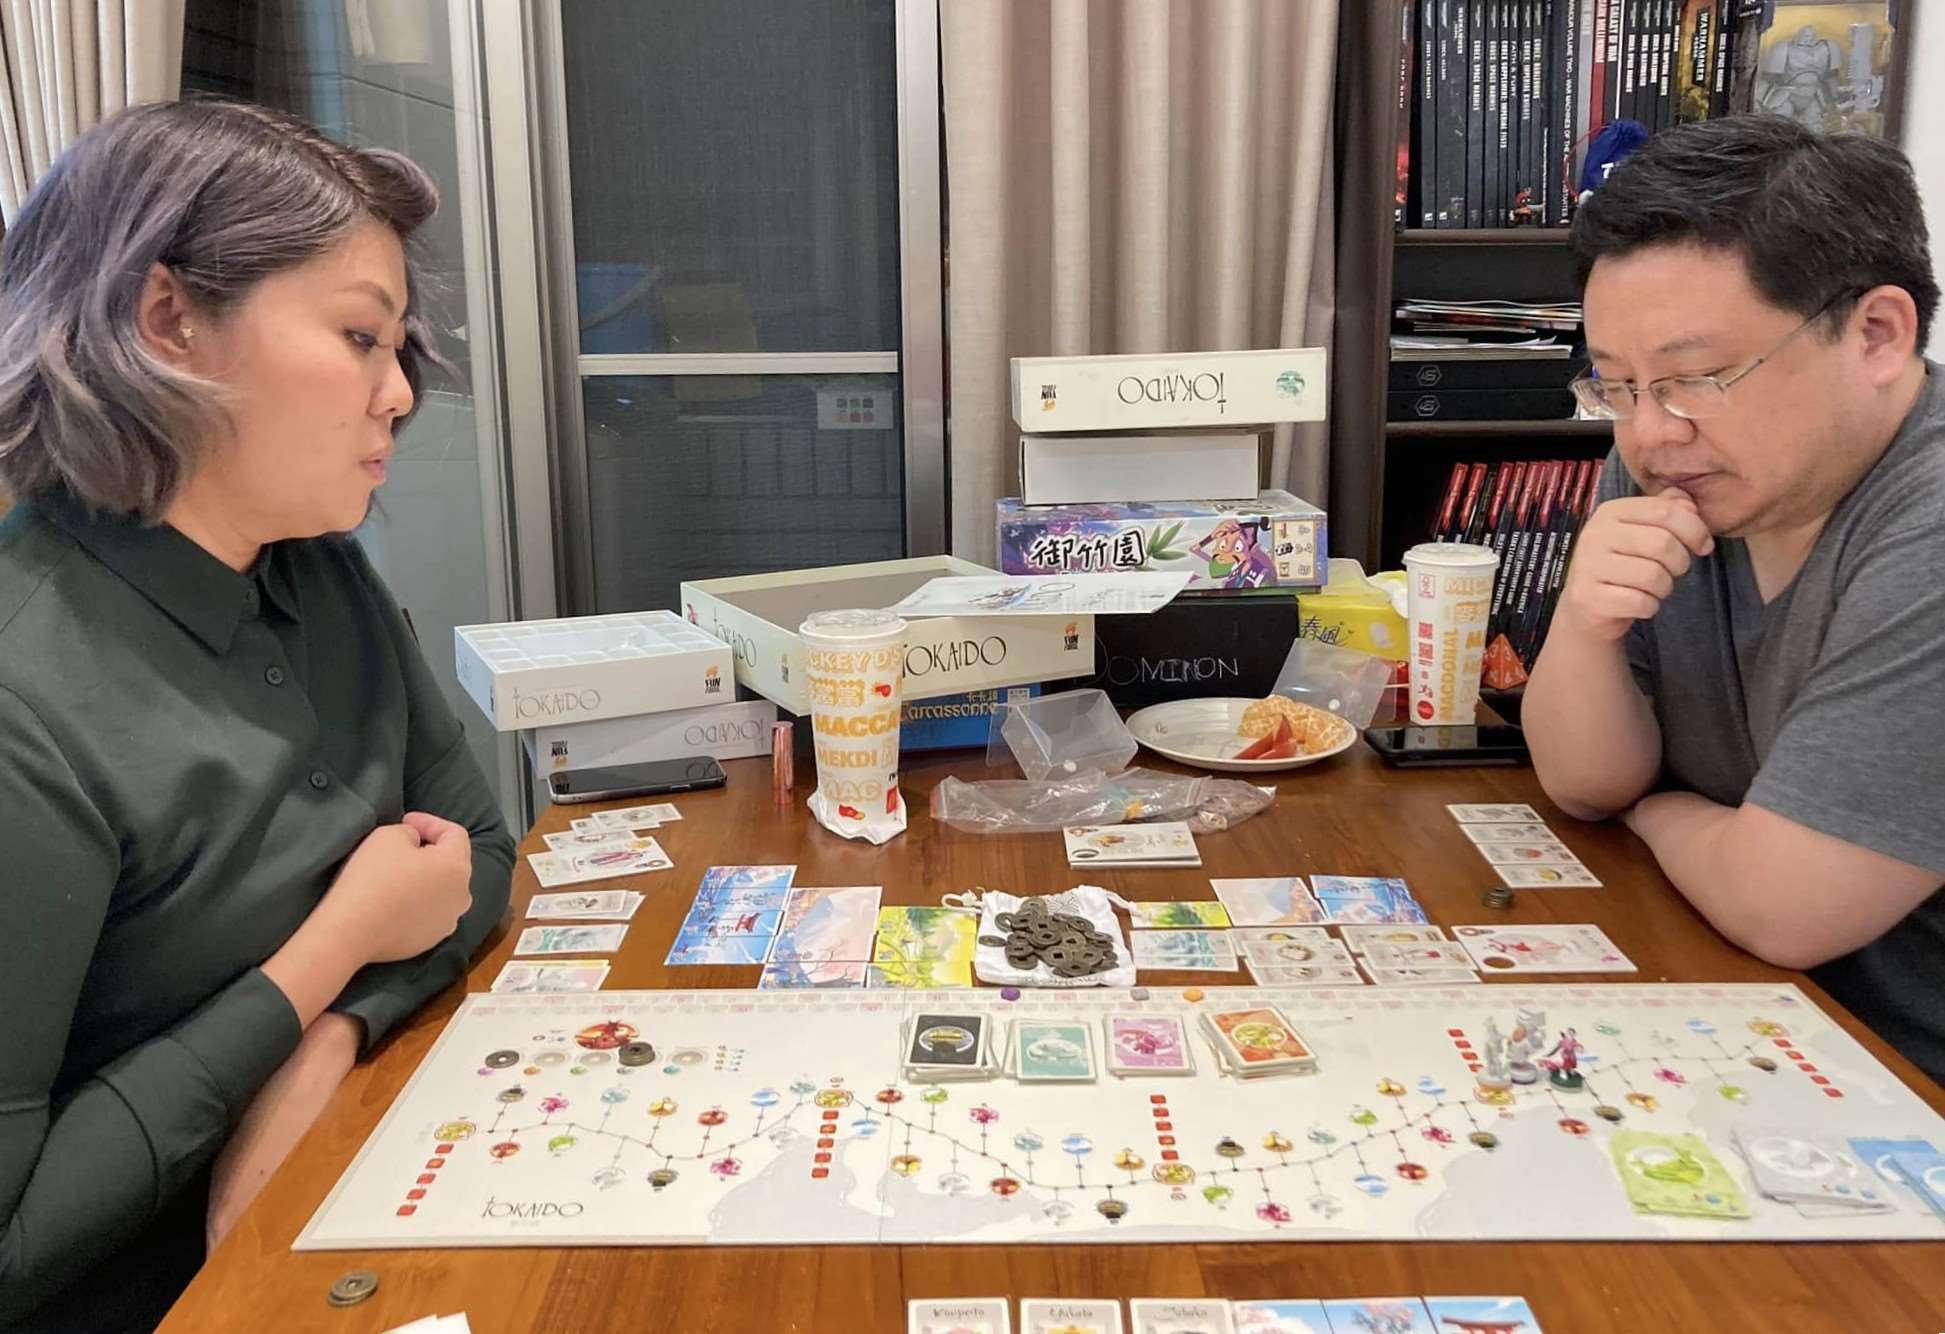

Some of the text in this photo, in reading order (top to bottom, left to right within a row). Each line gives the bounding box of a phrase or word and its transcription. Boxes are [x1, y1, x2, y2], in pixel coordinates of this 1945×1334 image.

[1456, 7, 1464, 54] WARHAMMER
[1609, 6, 1620, 34] GALAXY
[1566, 29, 1574, 56] VOLUME
[1607, 45, 1618, 62] WAR
[1696, 12, 1709, 82] WARHAMMER
[1473, 64, 1481, 83] SPACE
[1488, 64, 1497, 84] SPACE
[1522, 64, 1531, 93] IMPERIAL
[1565, 58, 1573, 73] TWO
[1472, 84, 1481, 111] MARINES
[1488, 85, 1497, 111] MARINES
[1565, 80, 1573, 94] WAR
[1500, 103, 1508, 130] IMPERIAL
[1521, 94, 1530, 120] KNIGHTS
[1563, 95, 1572, 129] MACHINES
[1563, 141, 1571, 154] THE
[1564, 130, 1571, 140] OF
[1118, 372, 1228, 414] TOKAIDO
[1030, 530, 1145, 571] 御竹園
[1491, 584, 1506, 615] EVERYTHING
[1517, 592, 1528, 613] RAVNICA
[512, 687, 601, 720] TOKAIDO
[684, 717, 765, 749] TOKAIDO
[480, 1195, 584, 1219] TOKAIDO
